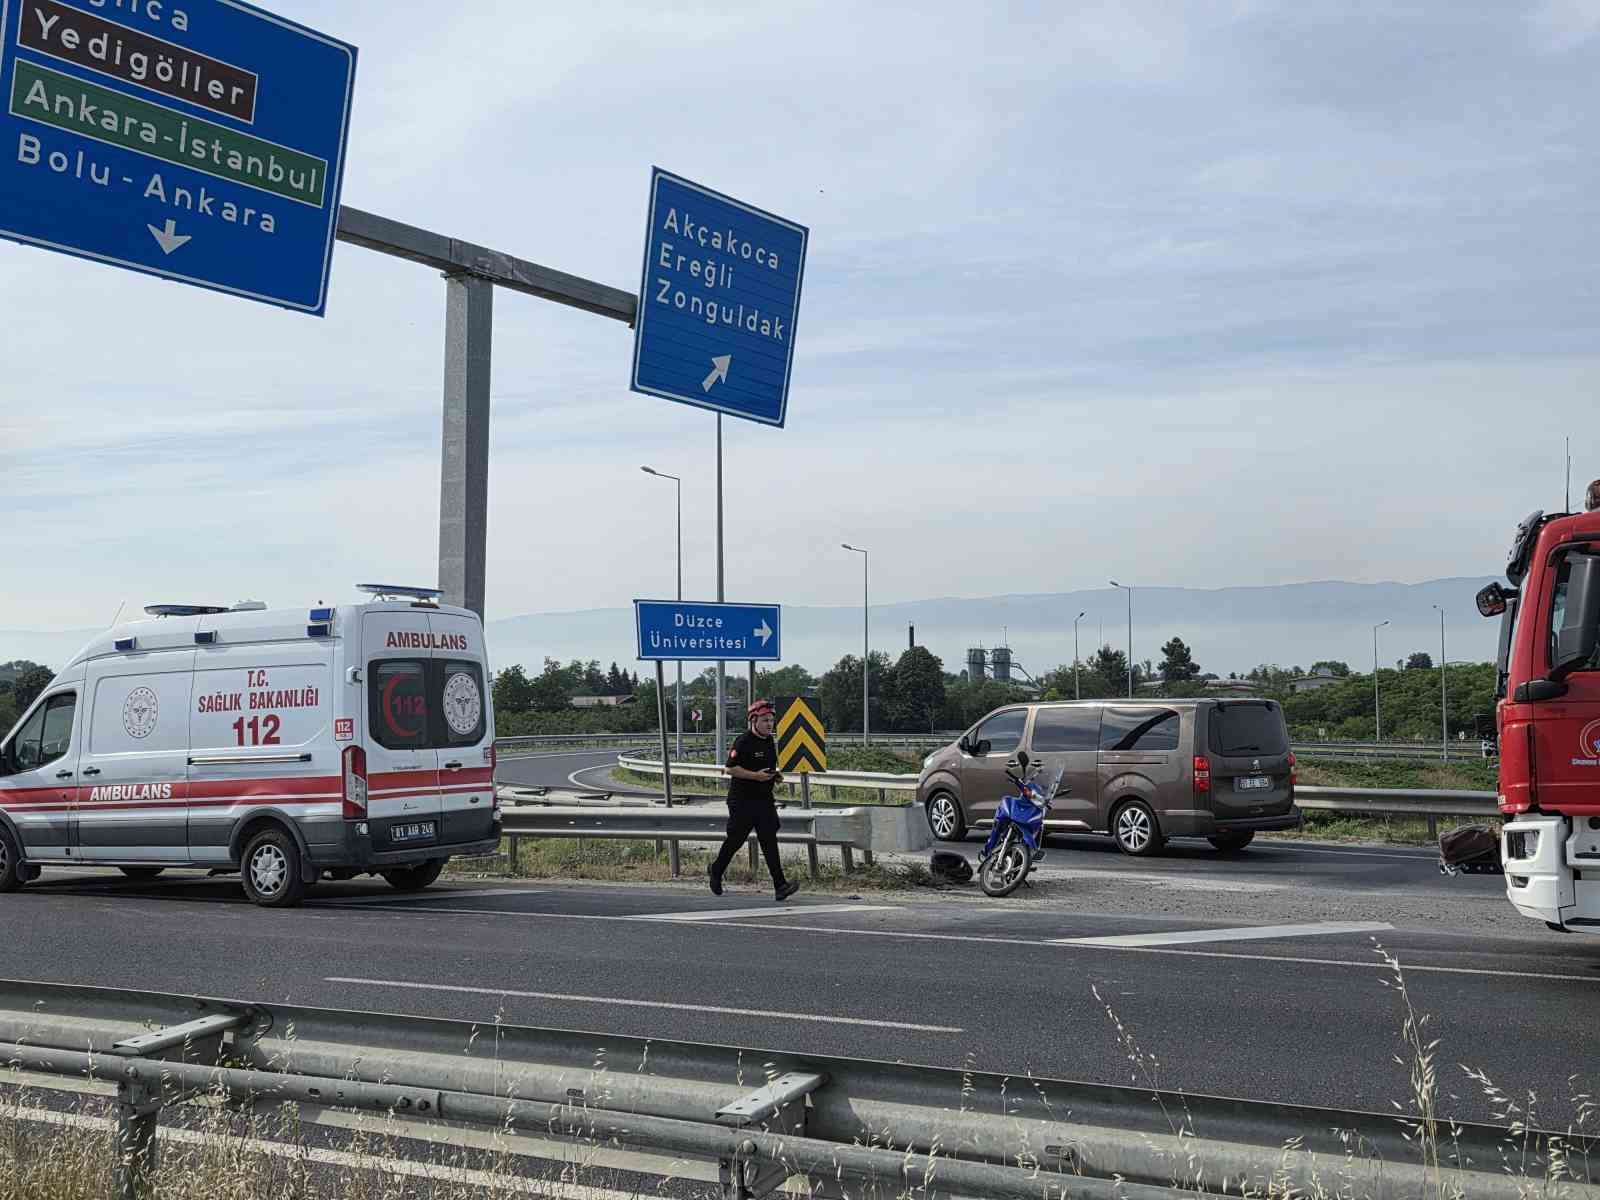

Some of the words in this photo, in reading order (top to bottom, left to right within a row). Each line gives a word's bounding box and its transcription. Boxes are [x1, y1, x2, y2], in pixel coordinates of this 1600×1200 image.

[35, 8, 244, 105] Yedigöller
[24, 79, 317, 193] Ankara-İstanbul
[18, 133, 111, 187] Bolu
[144, 174, 276, 234] Ankara
[663, 208, 779, 270] Akçakoca
[659, 242, 733, 289] Ereğli
[655, 278, 785, 341] Zonguldak
[674, 613, 724, 628] Düzce
[386, 631, 468, 650] AMBULANS
[650, 631, 746, 649] Üniversitesi
[247, 670, 269, 688] T.C.
[198, 691, 242, 713] SAĞLIK
[249, 684, 319, 710] BAKANLIĞI
[395, 695, 425, 715] 112
[232, 714, 281, 747] 112
[337, 720, 352, 732] 112
[90, 783, 172, 801] AMBULANS
